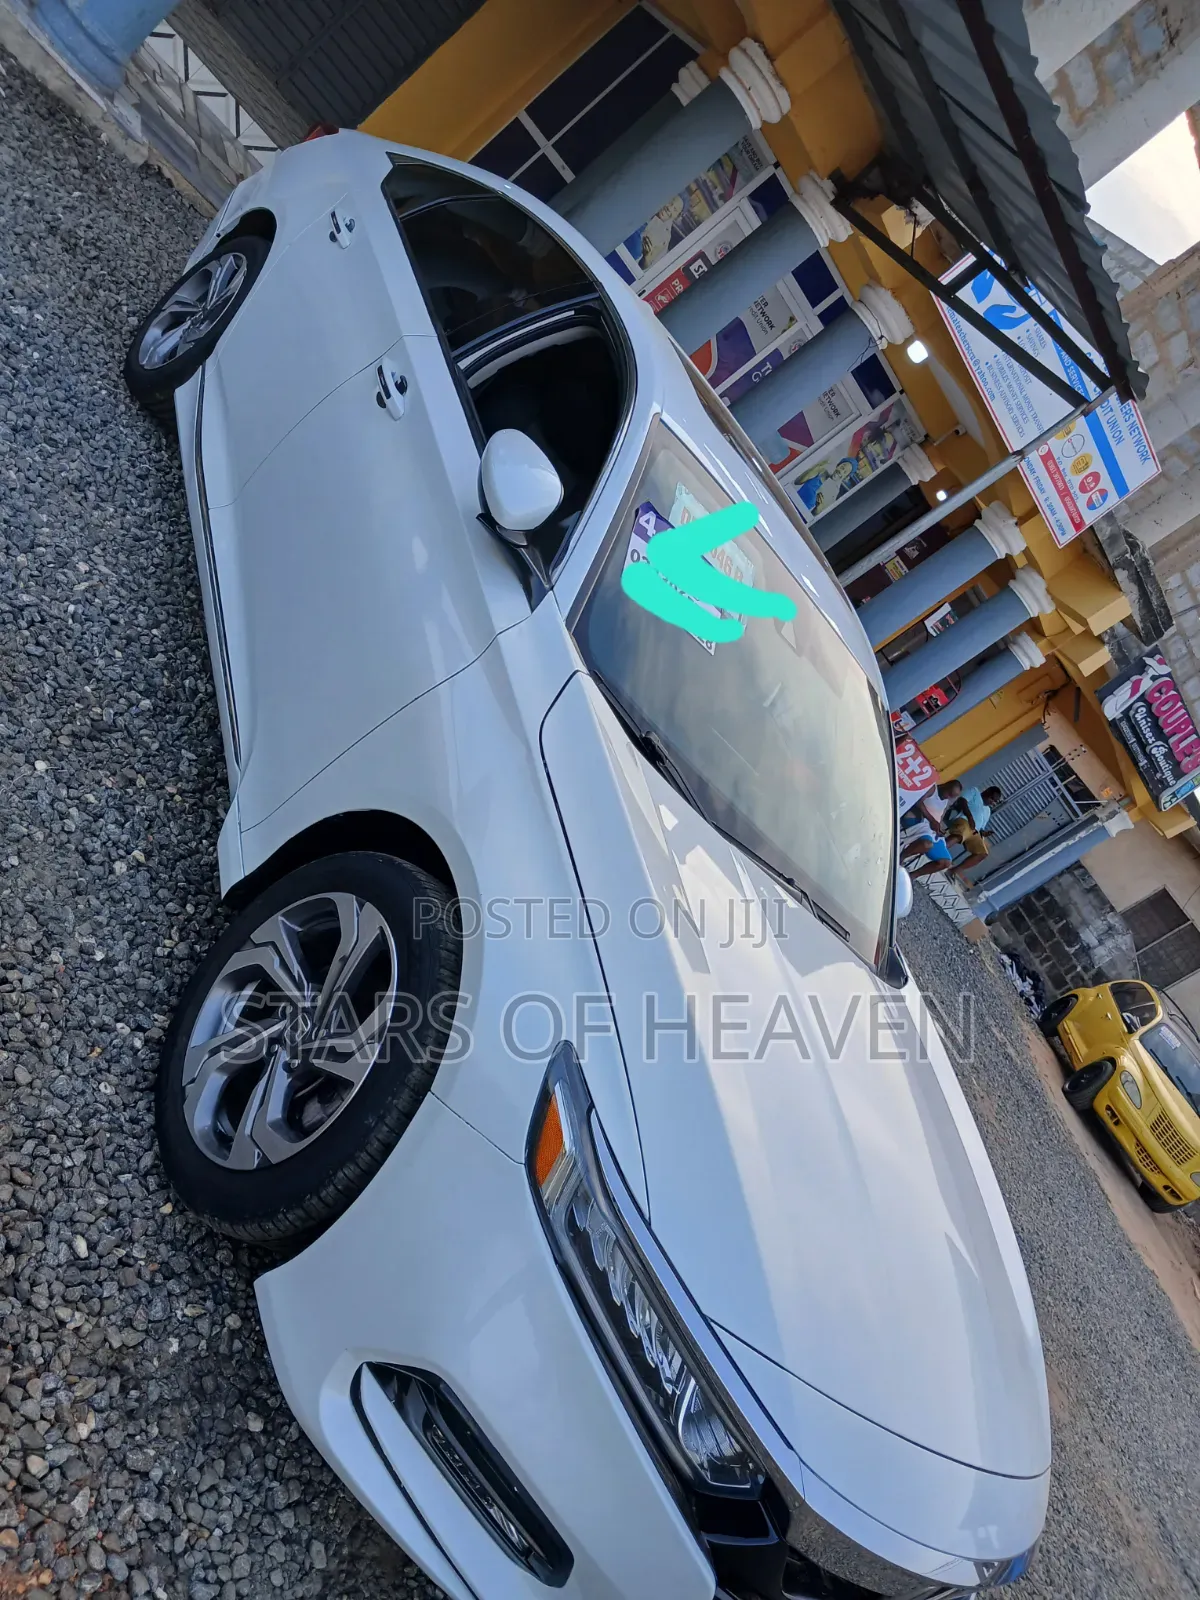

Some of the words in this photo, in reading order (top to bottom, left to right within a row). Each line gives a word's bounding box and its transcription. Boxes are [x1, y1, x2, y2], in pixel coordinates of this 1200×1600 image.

[1059, 350, 1072, 366] AND
[1010, 414, 1025, 437] SERVICES
[1015, 401, 1029, 424] SERVICES
[1106, 414, 1124, 445] UNION
[1126, 418, 1151, 465] NETWORK
[1033, 476, 1045, 494] FRIDAY
[1133, 705, 1156, 744] Unisex
[1149, 740, 1177, 786] Boutique
[895, 741, 933, 787] 2+2
